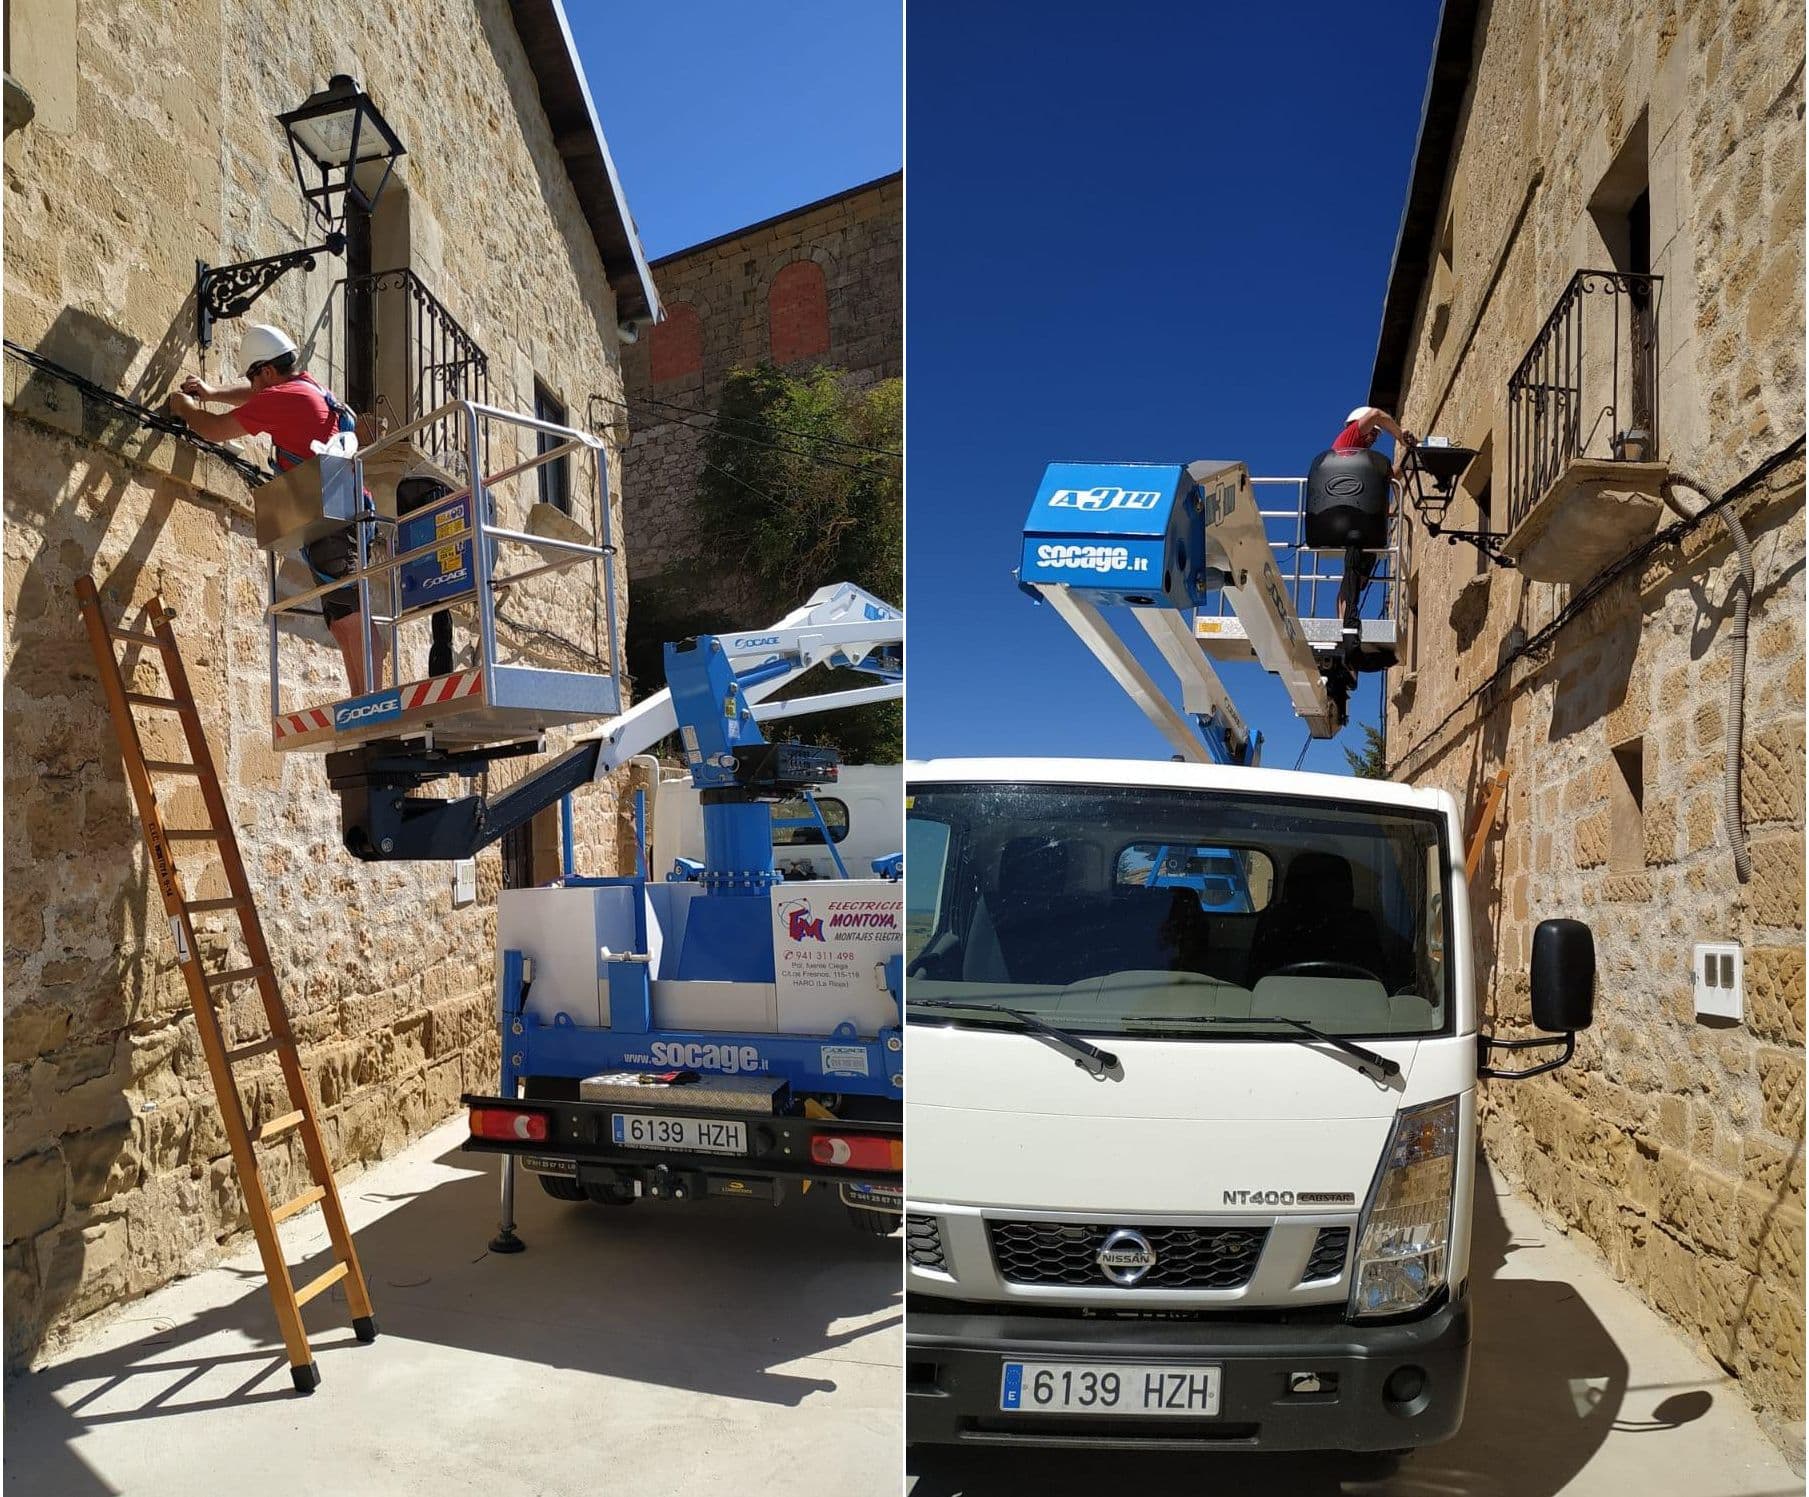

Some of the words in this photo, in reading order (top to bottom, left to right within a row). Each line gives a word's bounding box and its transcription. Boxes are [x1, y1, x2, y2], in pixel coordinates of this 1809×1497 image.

[1048, 487, 1161, 511] A314
[1036, 544, 1149, 573] socage.it
[735, 636, 780, 650] SOCAGE
[336, 699, 399, 724] SOCAGE
[829, 913, 897, 929] MONTOYA,
[834, 932, 873, 942] MONTAJES
[796, 951, 812, 960] 941
[817, 951, 832, 961] 311
[837, 952, 854, 961] 498
[631, 1120, 683, 1143] 6139
[698, 1123, 739, 1148] HZH
[1223, 1190, 1295, 1206] NT400
[1102, 1254, 1150, 1264] NISSAN
[1007, 1391, 1017, 1401] E
[1033, 1370, 1121, 1406] 6139
[1143, 1373, 1209, 1409] HZH
